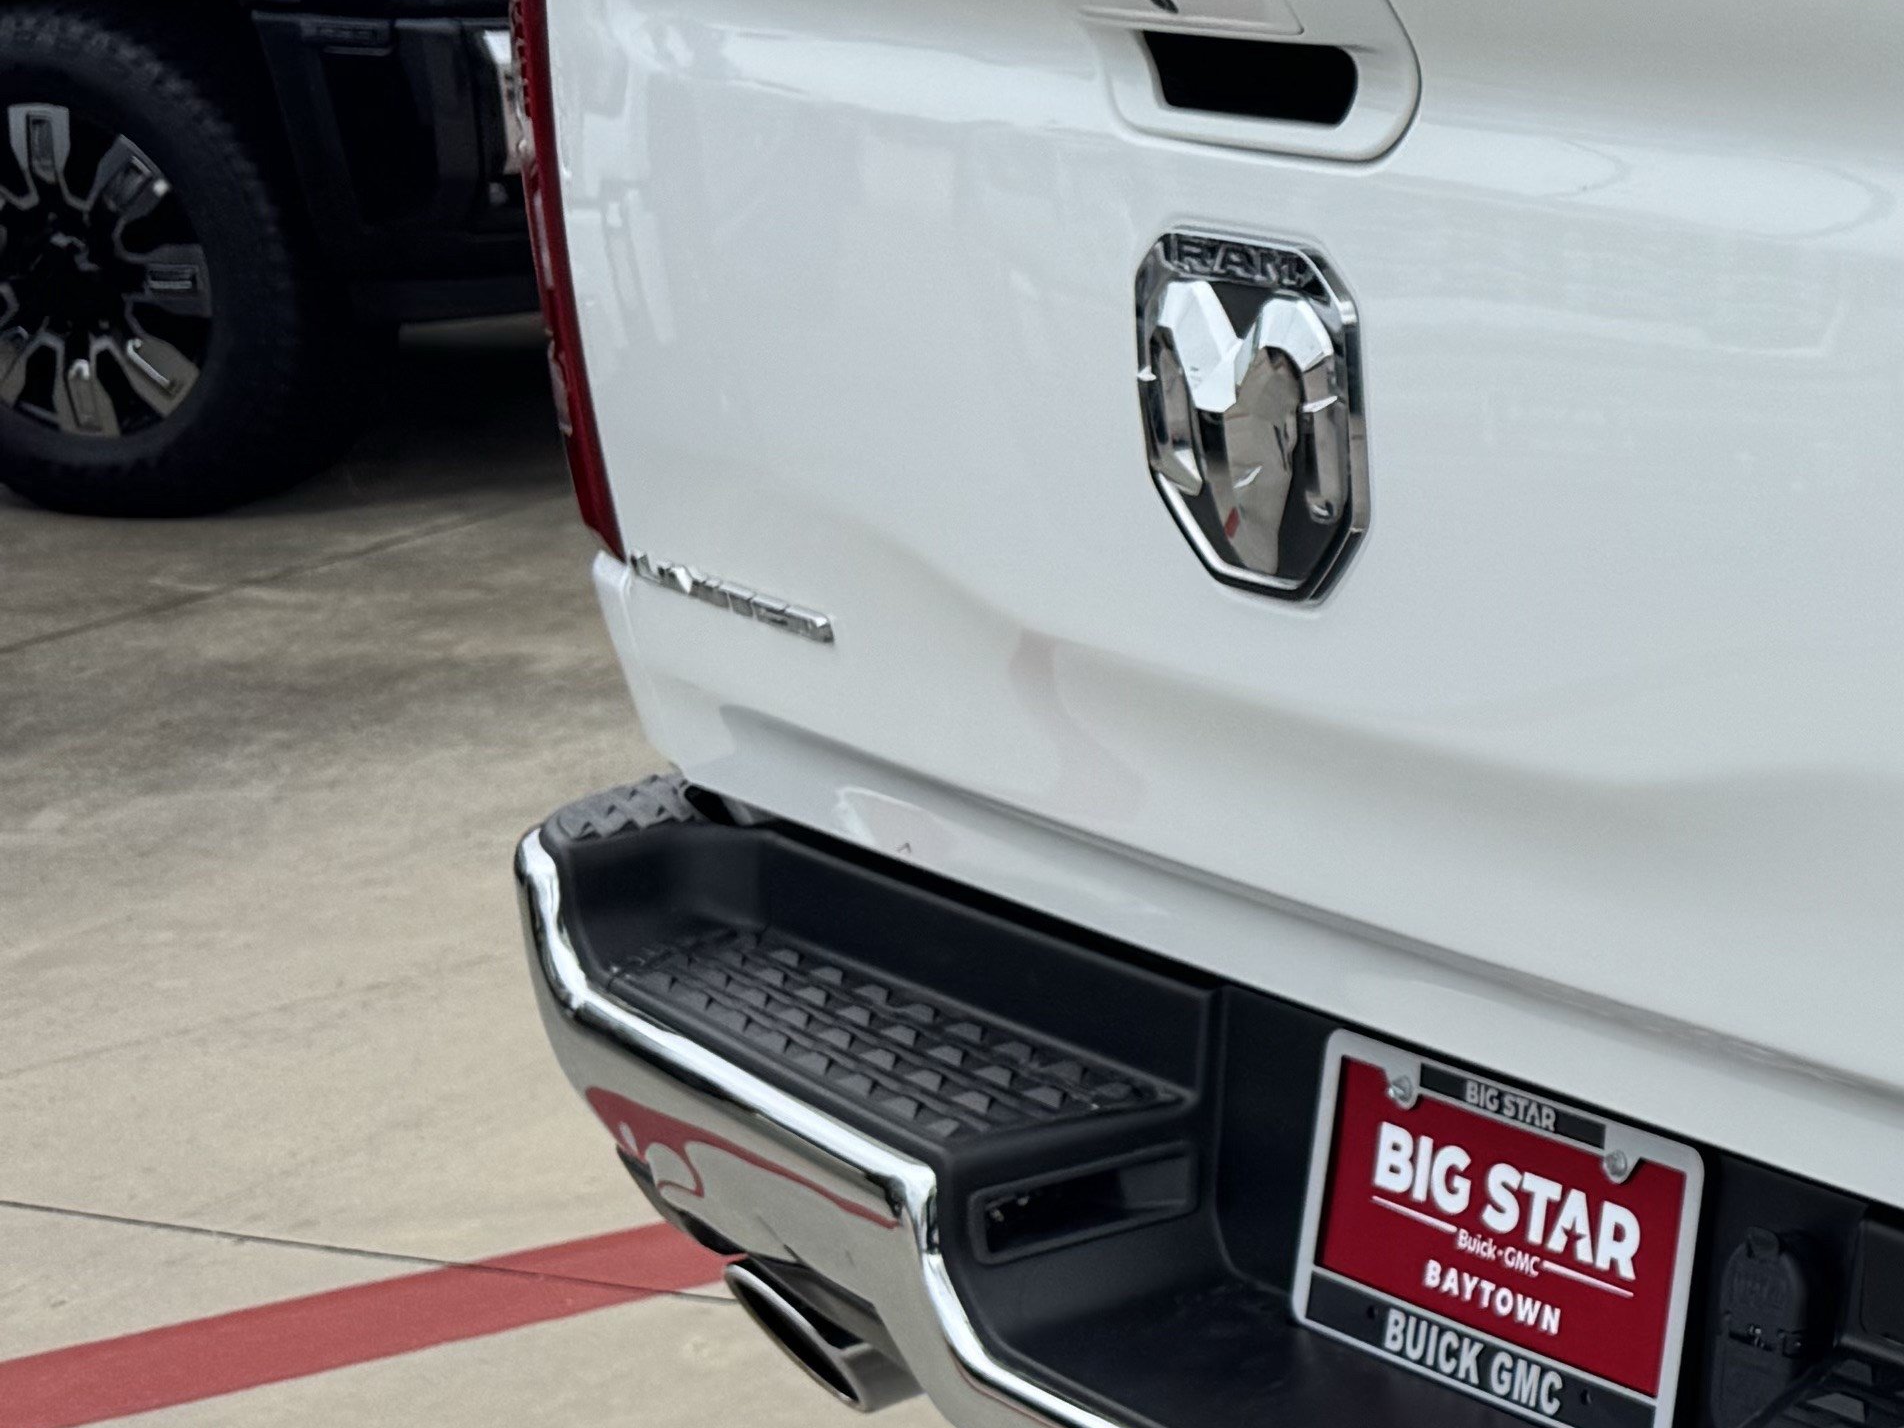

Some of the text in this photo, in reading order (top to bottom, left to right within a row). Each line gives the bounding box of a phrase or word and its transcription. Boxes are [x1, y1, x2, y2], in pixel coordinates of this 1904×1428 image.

[1465, 1079, 1557, 1133] BIG STAR
[1373, 1120, 1642, 1281] BIG STAR
[1423, 1259, 1562, 1335] BAYTOWN
[1384, 1307, 1564, 1417] BUICK GMC
